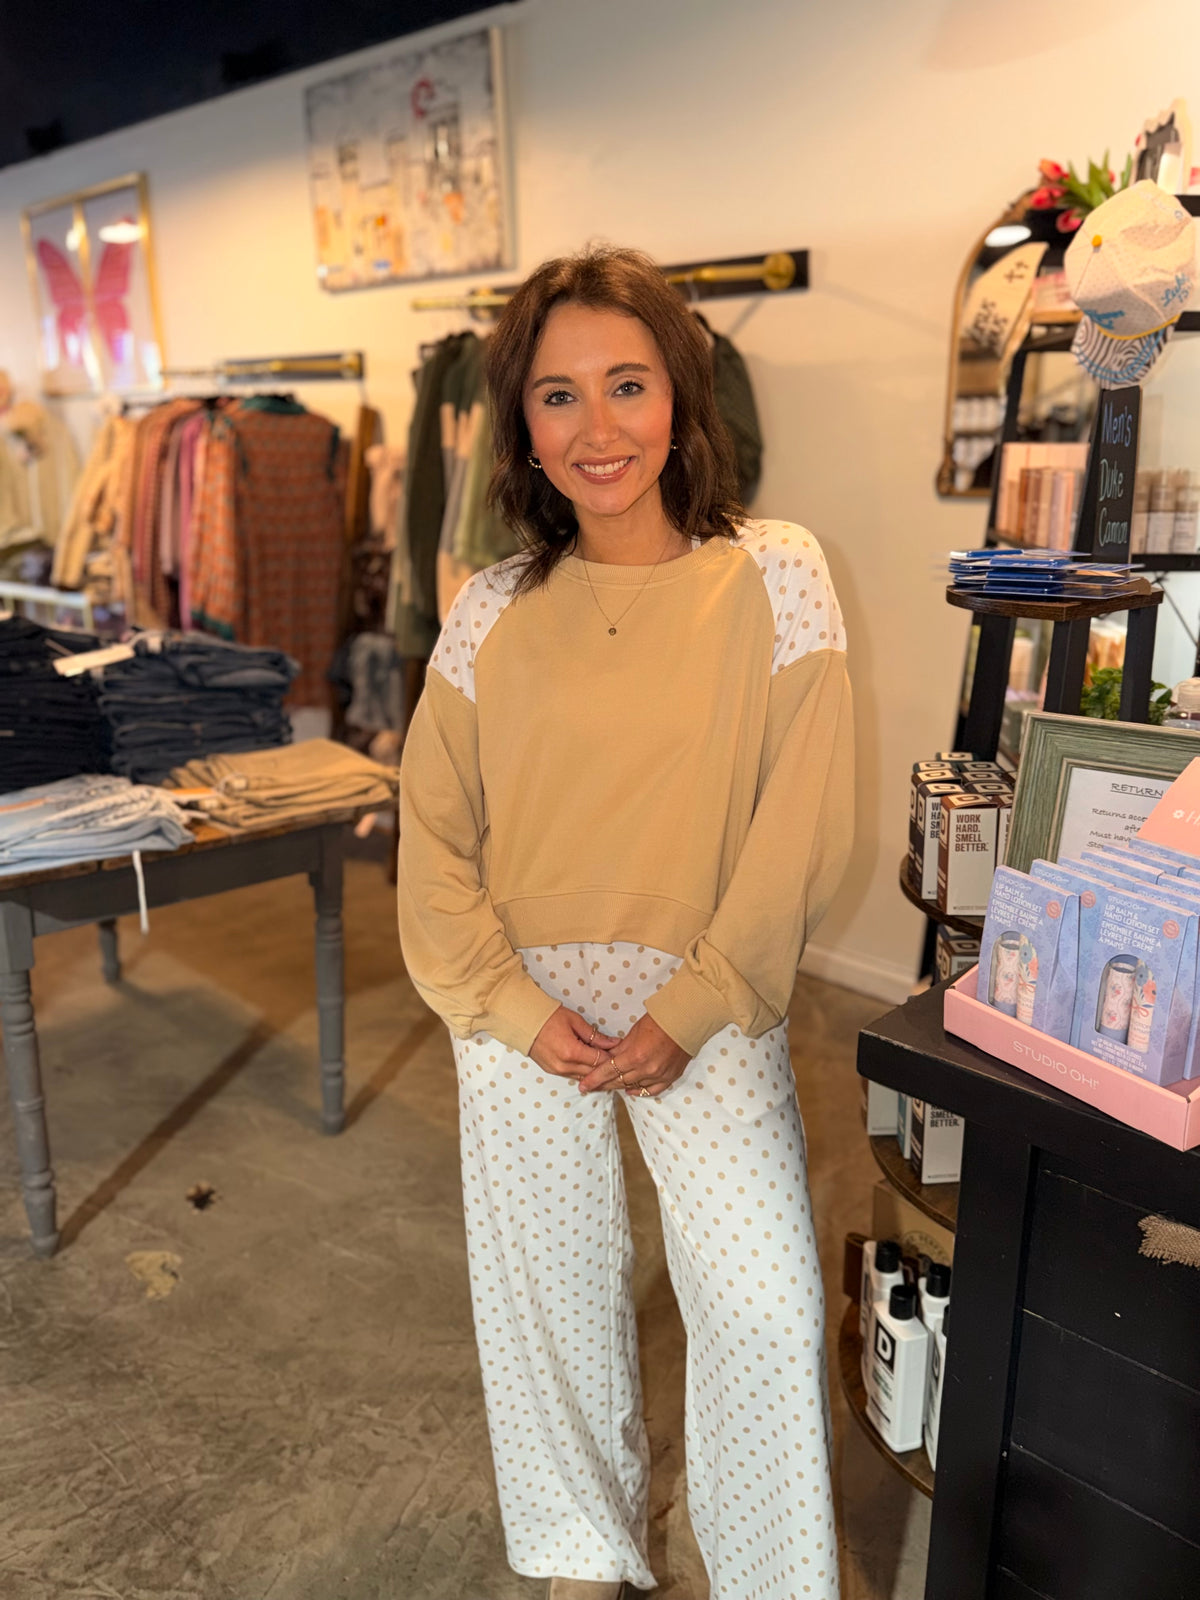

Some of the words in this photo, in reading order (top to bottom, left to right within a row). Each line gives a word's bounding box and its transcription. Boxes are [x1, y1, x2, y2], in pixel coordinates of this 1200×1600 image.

[1101, 403, 1132, 447] Men's
[1099, 458, 1124, 501] Duke
[956, 814, 981, 824] WORK
[1092, 808, 1127, 819] Returns
[955, 824, 981, 833] HARD.
[955, 833, 982, 843] SMELL
[954, 842, 989, 852] BETTER.
[1105, 903, 1115, 912] LIP
[1115, 907, 1133, 918] BALM
[1103, 910, 1122, 922] HAND
[1122, 916, 1147, 931] LOTION
[1147, 925, 1160, 935] SET
[1101, 920, 1132, 936] ENSEMBLE
[1133, 932, 1155, 946] BAUME
[1013, 1040, 1068, 1074] STUDIO
[876, 1327, 892, 1362] D
